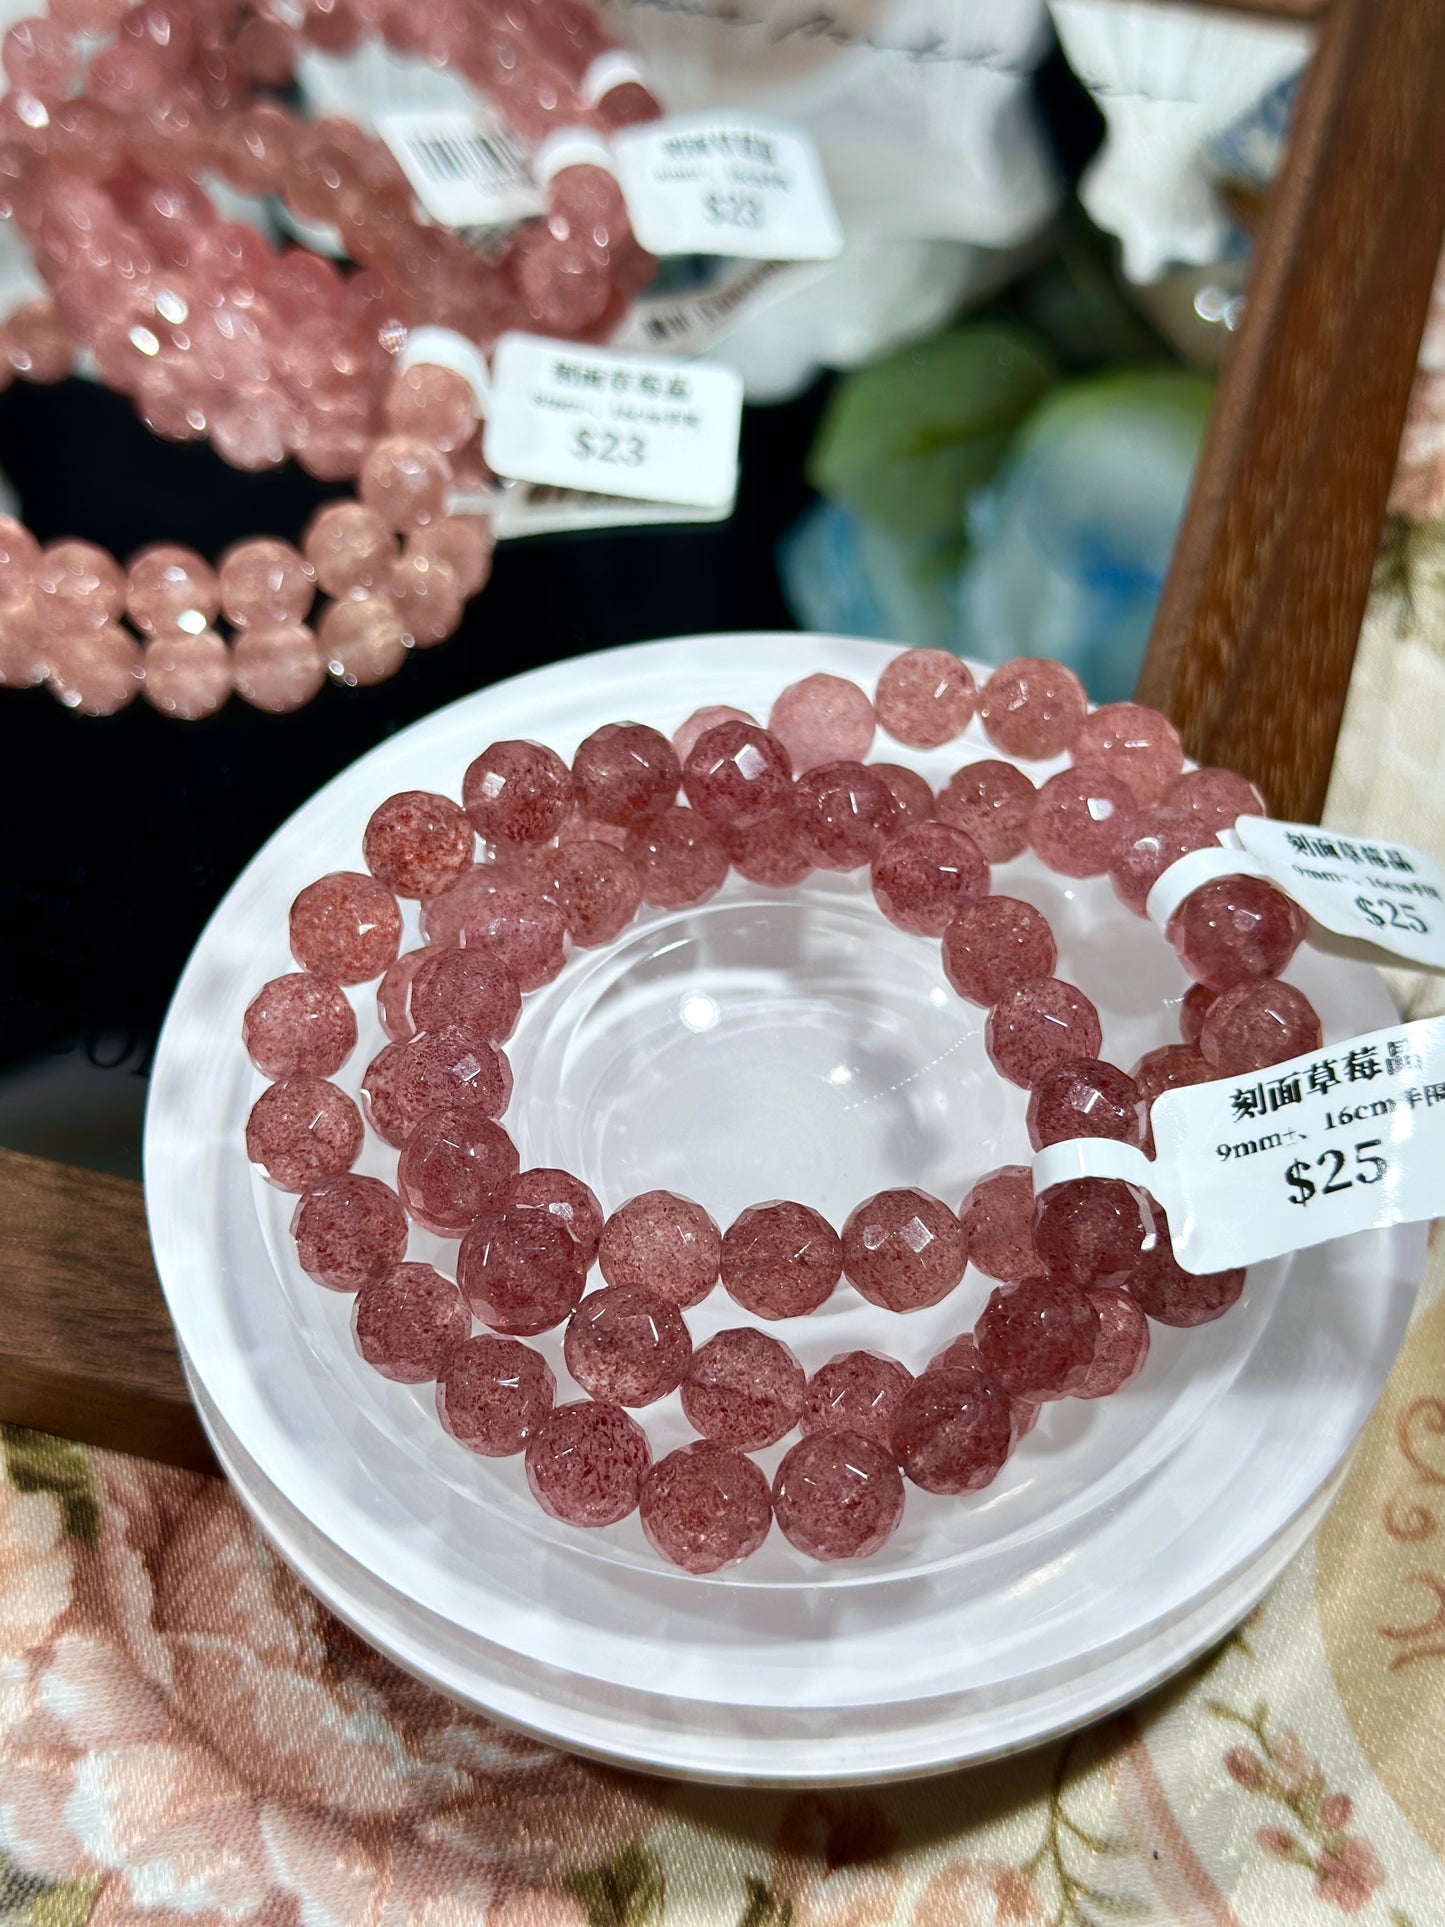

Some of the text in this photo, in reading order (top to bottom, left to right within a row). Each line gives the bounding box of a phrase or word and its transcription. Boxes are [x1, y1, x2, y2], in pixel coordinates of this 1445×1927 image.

[574, 428, 646, 467] $23
[1355, 895, 1429, 934] $25
[1284, 1138, 1390, 1207] $25
